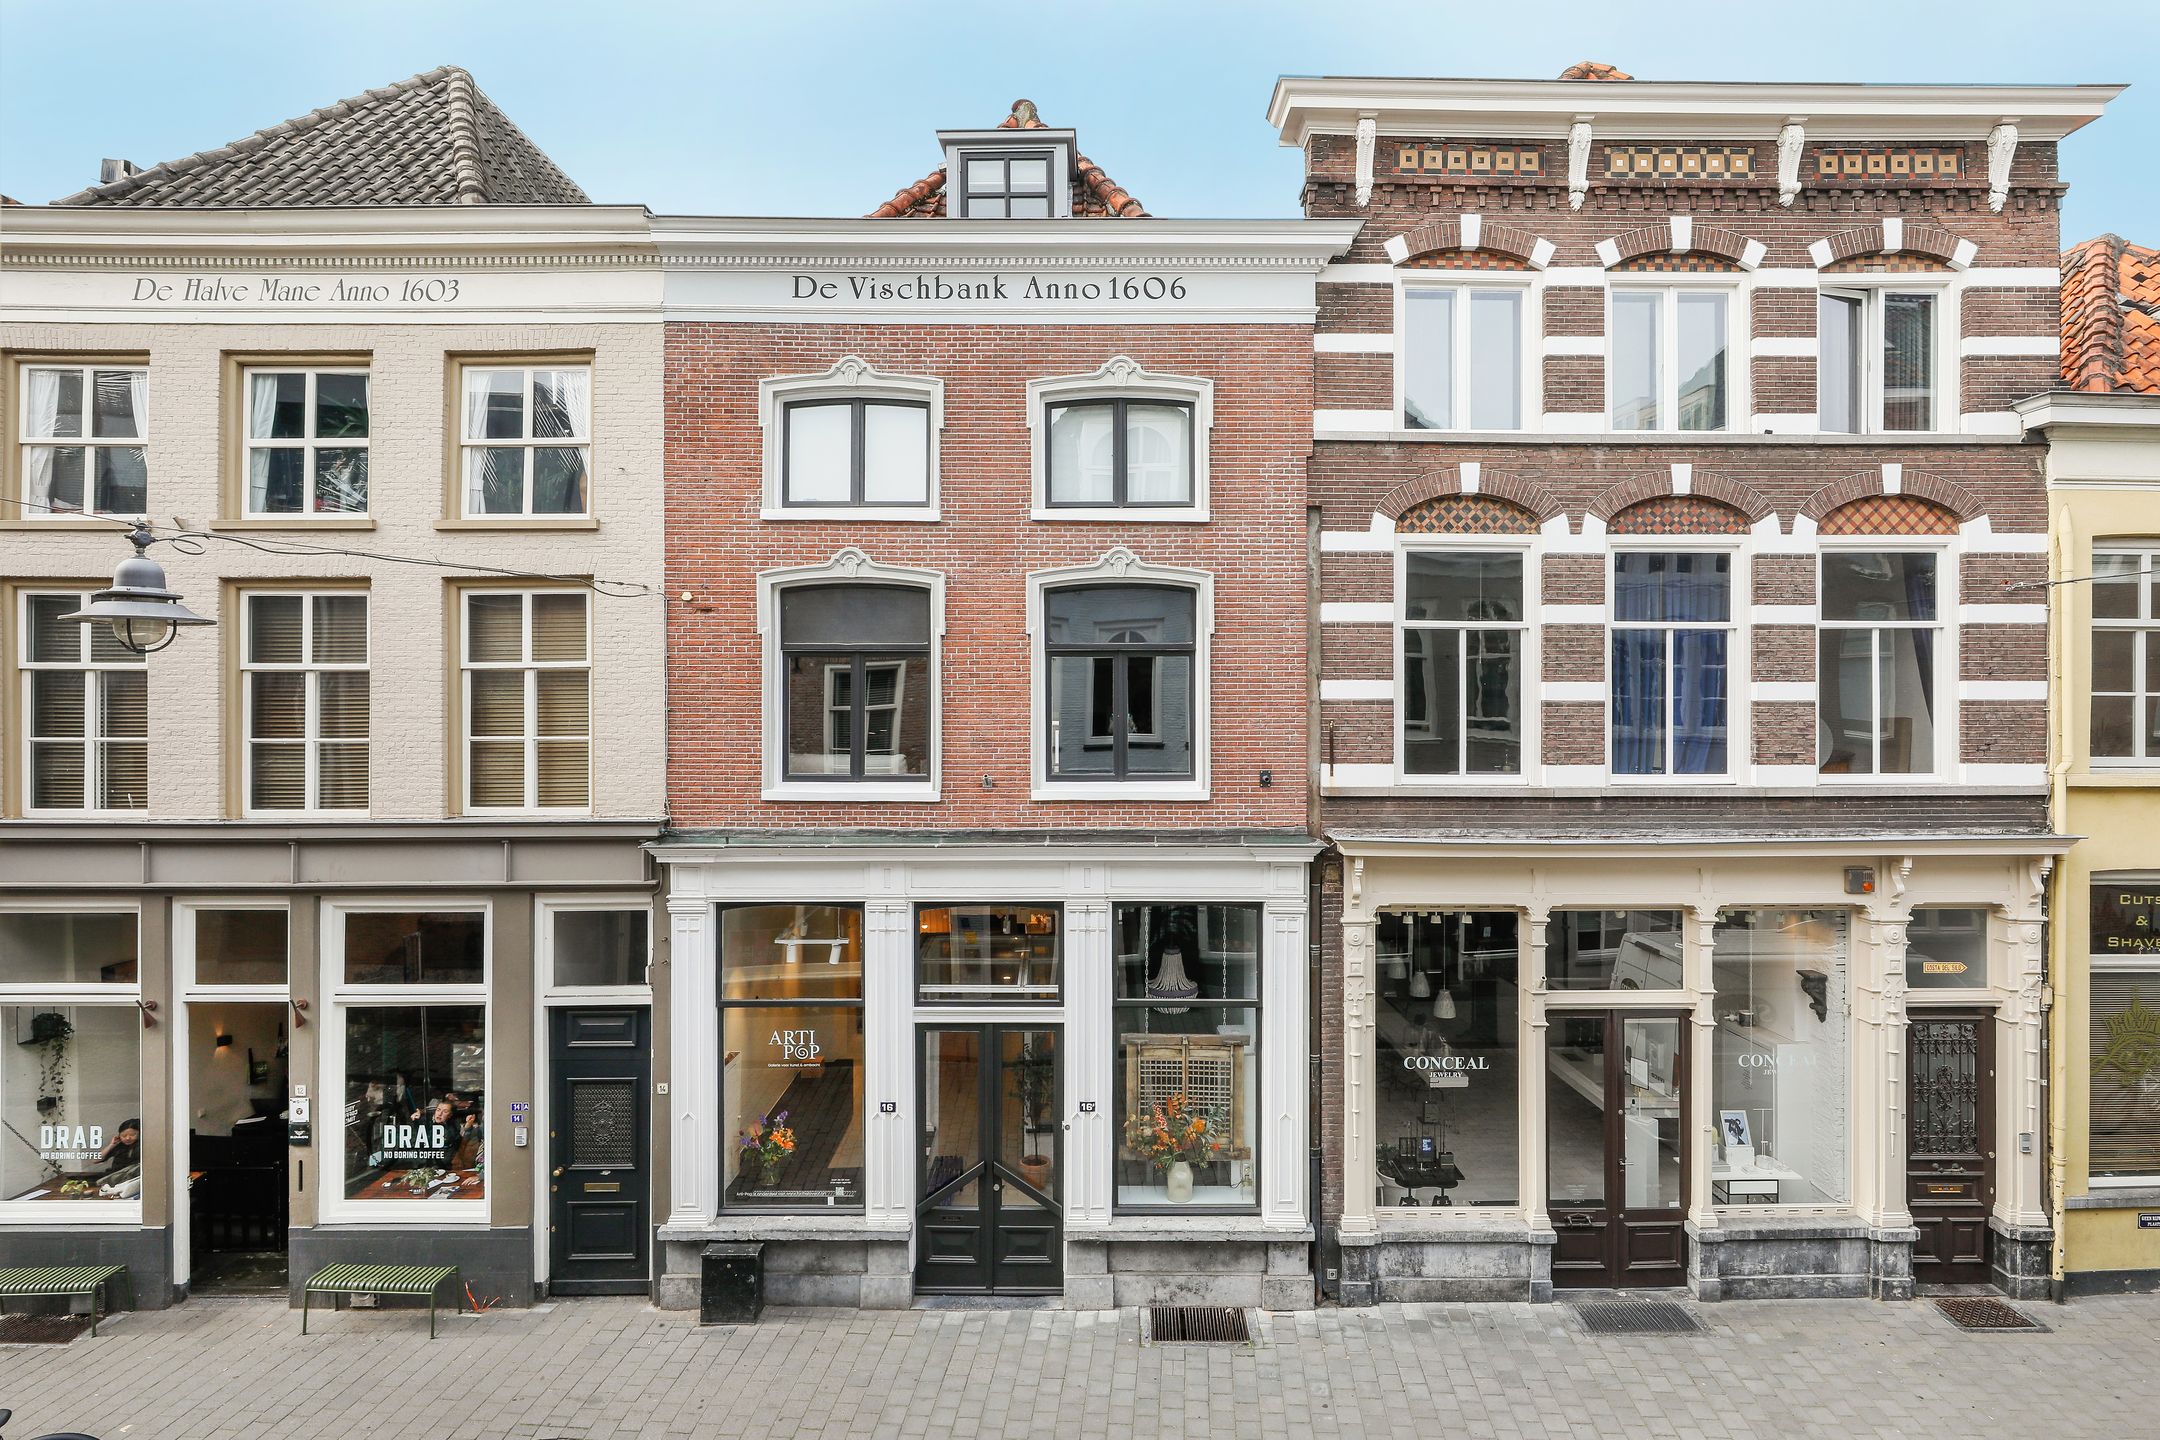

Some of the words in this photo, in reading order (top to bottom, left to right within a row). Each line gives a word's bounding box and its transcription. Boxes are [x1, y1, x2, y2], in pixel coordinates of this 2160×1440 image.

[132, 278, 173, 301] De
[182, 277, 249, 301] Halve
[258, 278, 321, 301] Mane
[328, 278, 390, 301] Anno
[398, 278, 460, 302] 1603
[792, 275, 838, 300] De
[848, 274, 1008, 300] Vischbank
[1023, 275, 1100, 300] Anno
[1108, 276, 1187, 300] 1606
[2135, 915, 2148, 926] &
[768, 1030, 816, 1045] ARTI
[1403, 1056, 1490, 1070] CONCEAL
[297, 1087, 304, 1095] 12
[881, 1103, 894, 1112] 16
[40, 1125, 103, 1149] DRAB
[384, 1124, 445, 1149] DRAB
[40, 1152, 49, 1160] NO
[51, 1152, 75, 1160] BORING
[76, 1152, 102, 1160] COFFEE
[383, 1151, 392, 1159] NO
[393, 1151, 418, 1159] BORING
[419, 1151, 445, 1159] COFFEE
